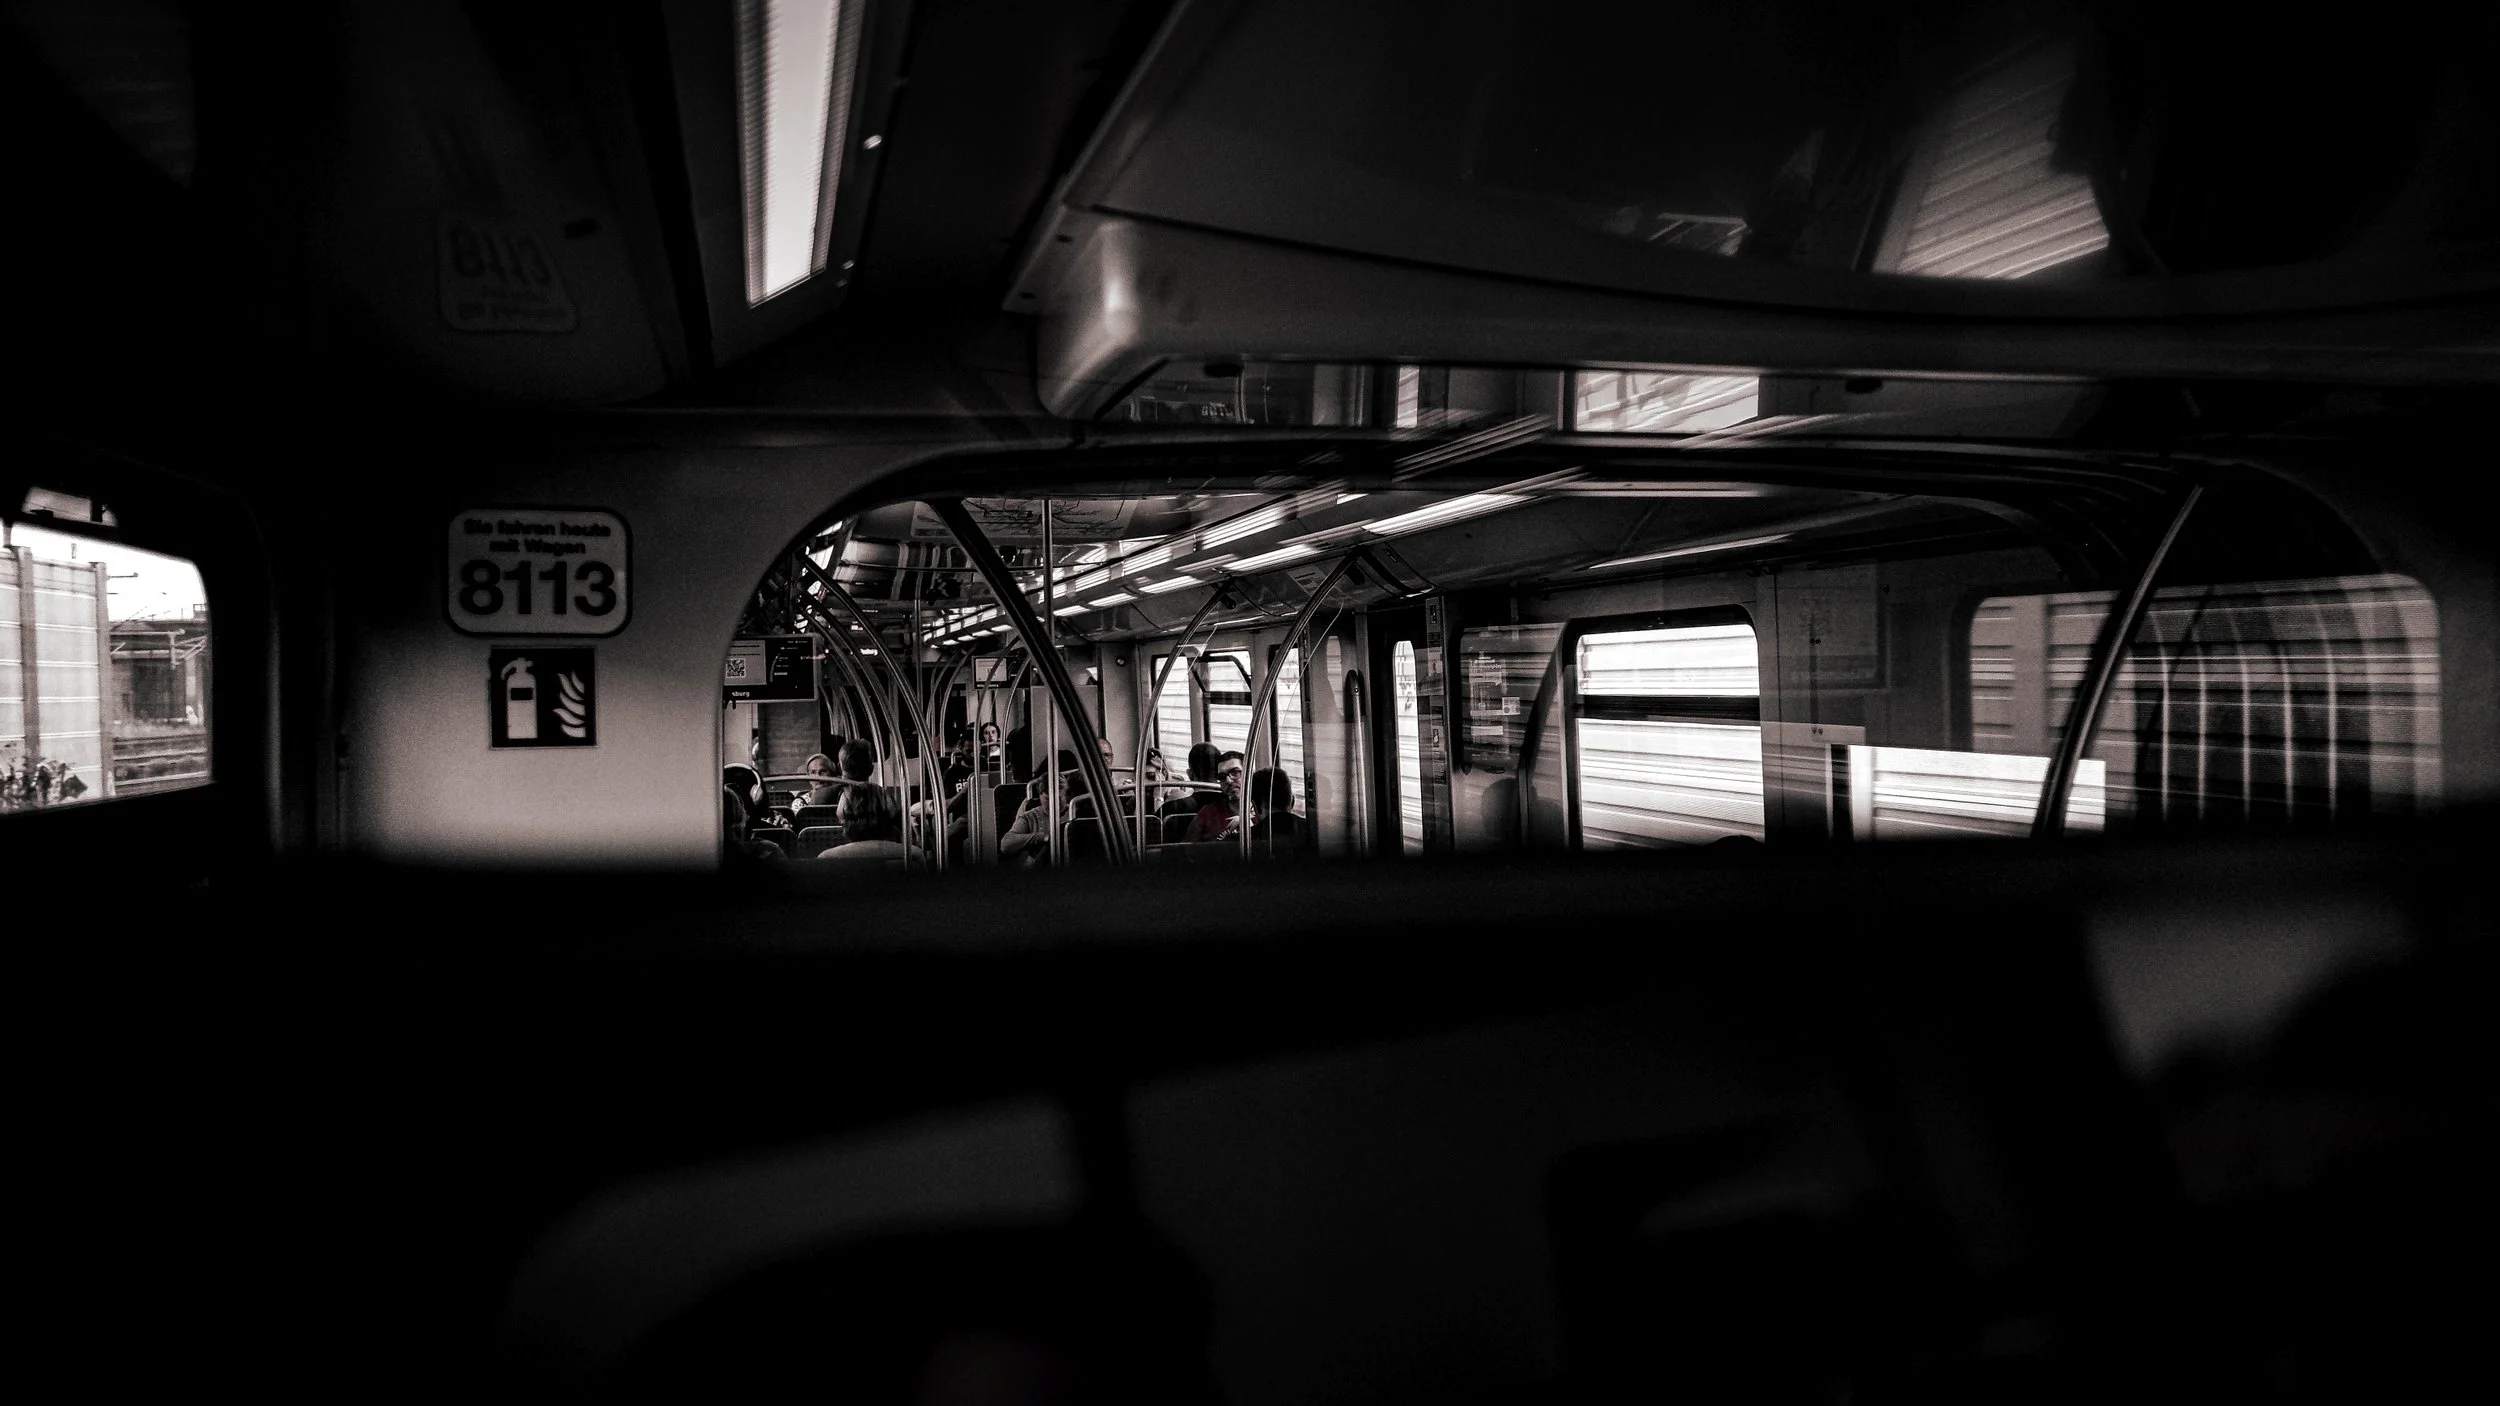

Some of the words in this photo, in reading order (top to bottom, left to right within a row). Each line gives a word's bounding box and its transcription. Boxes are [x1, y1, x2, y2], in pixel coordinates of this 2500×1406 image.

[464, 519, 493, 534] Sie
[498, 520, 555, 535] fahren
[560, 521, 611, 537] heute
[489, 539, 518, 552] mit
[524, 539, 586, 556] Wagen
[459, 560, 616, 616] 8113
